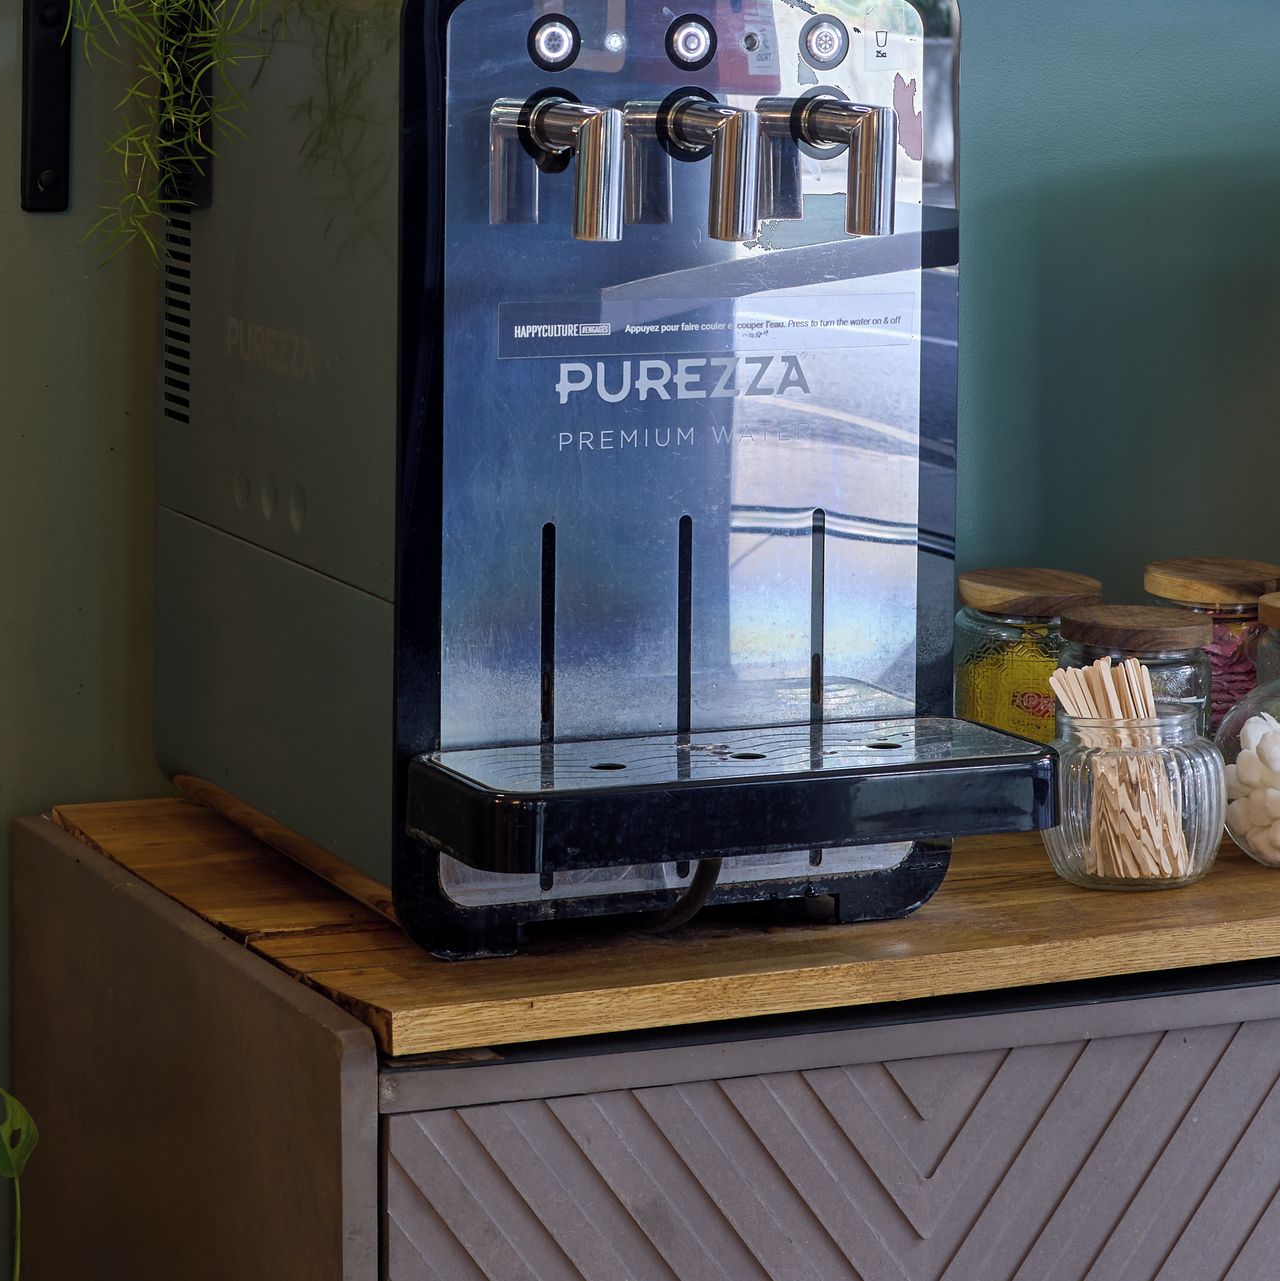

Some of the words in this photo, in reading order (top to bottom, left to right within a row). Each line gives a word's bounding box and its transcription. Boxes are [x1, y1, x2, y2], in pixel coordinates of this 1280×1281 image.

[514, 323, 579, 338] HAPPYCULTURE
[624, 324, 660, 334] Appuyez
[660, 323, 680, 333] pour
[681, 322, 699, 331] faire
[700, 321, 726, 330] couler
[736, 322, 765, 331] couper
[787, 319, 809, 328] Press
[810, 319, 819, 327] to
[820, 319, 835, 327] turn
[836, 318, 849, 326] the
[850, 318, 870, 326] water
[883, 316, 889, 324] &
[890, 315, 902, 324] off
[555, 355, 812, 404] PUREZZA
[558, 427, 695, 452] PREMIUM
[711, 422, 812, 445] WATER
